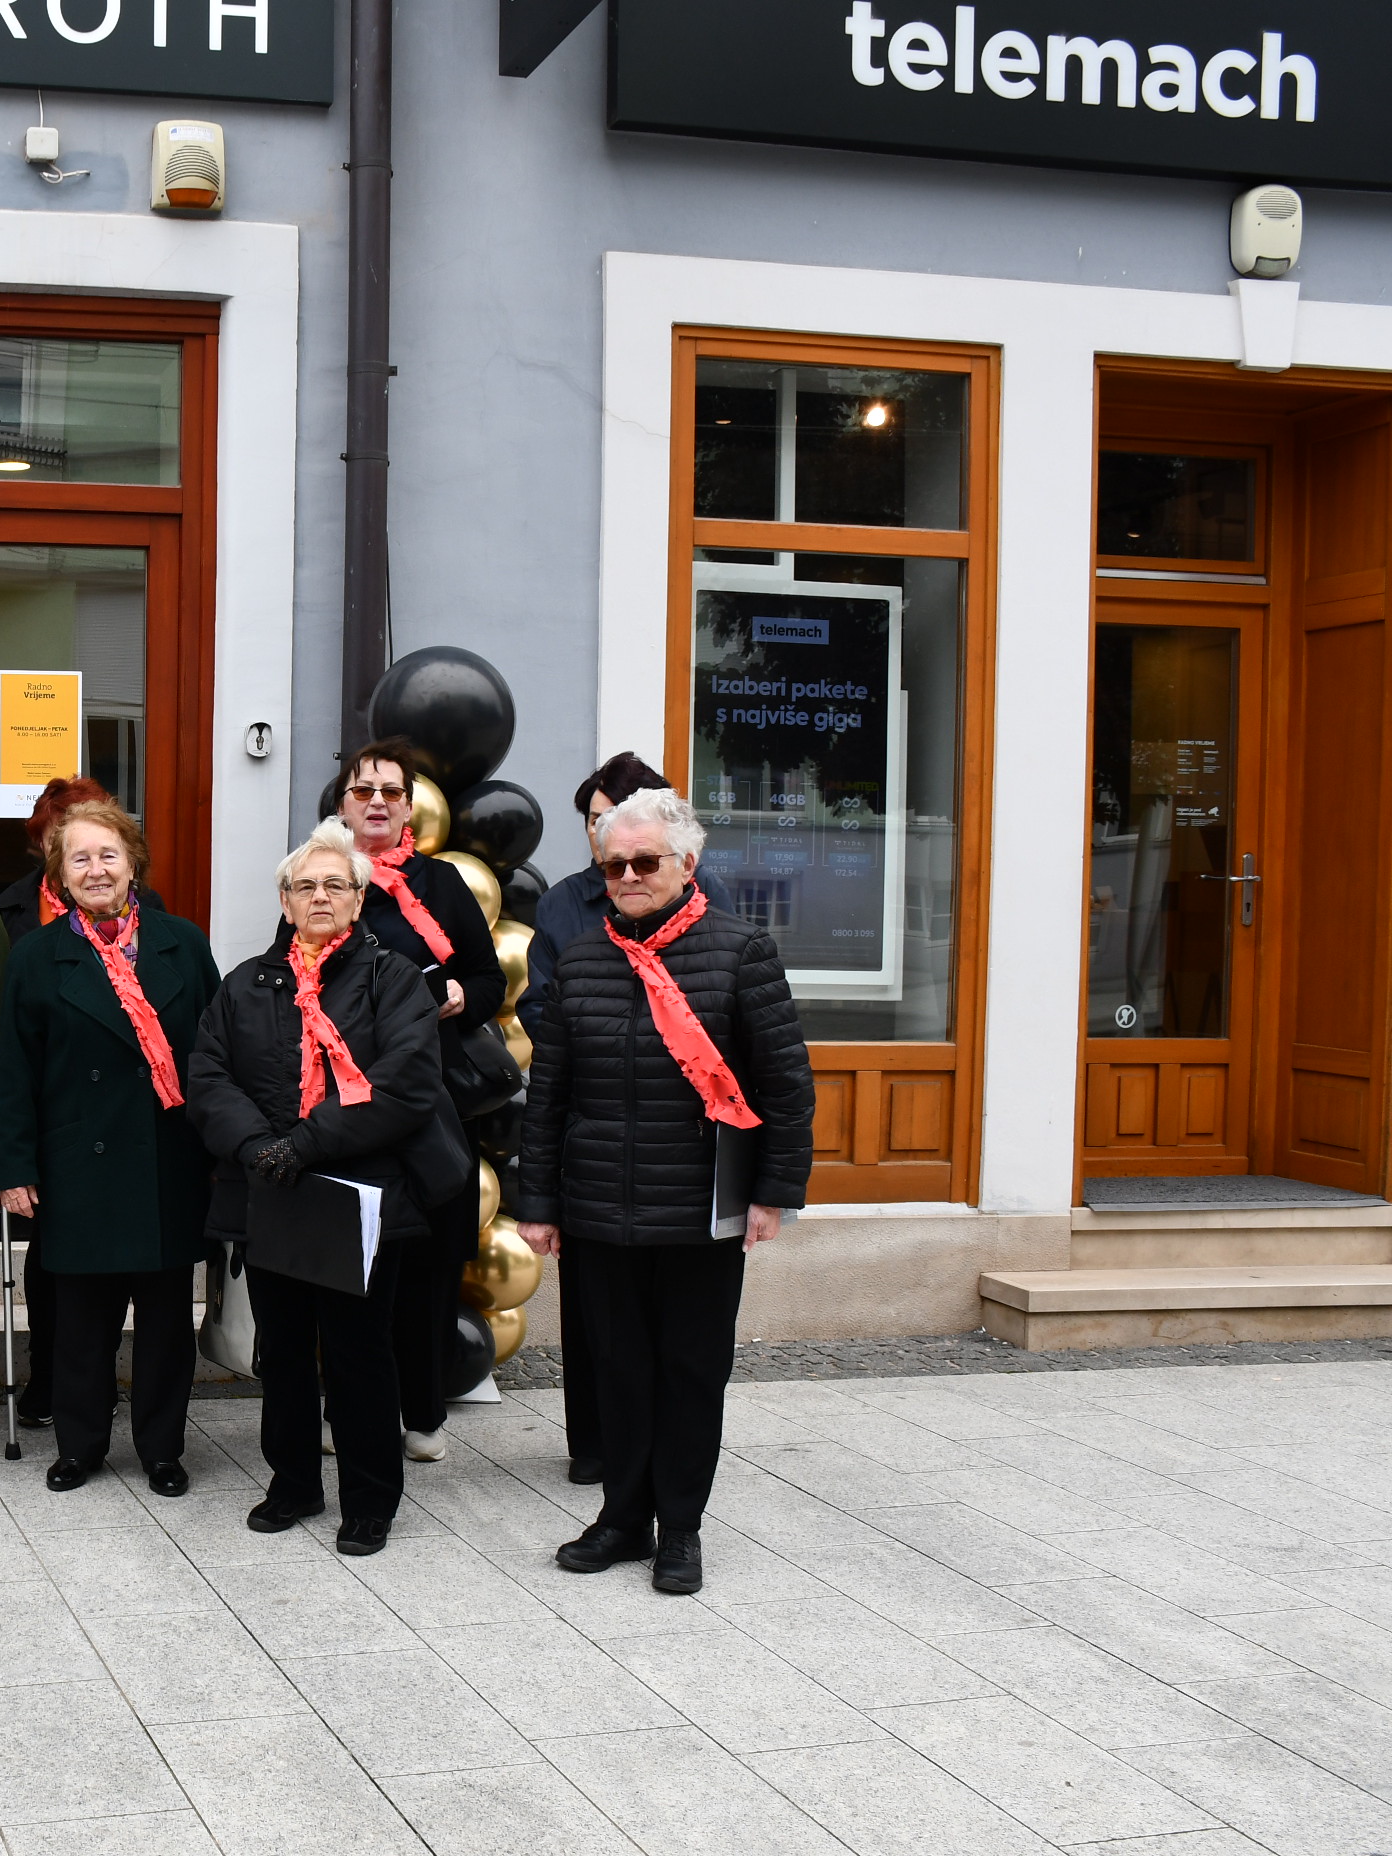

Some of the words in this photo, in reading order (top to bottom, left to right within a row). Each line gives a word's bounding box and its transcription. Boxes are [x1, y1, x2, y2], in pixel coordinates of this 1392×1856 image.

[845, 0, 1317, 122] telemach
[760, 624, 822, 638] telemach
[712, 675, 786, 696] Izaberi
[792, 679, 868, 702] pakete
[24, 691, 55, 700] Vrijeme
[716, 707, 727, 723] s
[733, 705, 809, 730] najviše
[814, 707, 862, 733] giga
[709, 792, 736, 803] 6GB
[770, 794, 806, 806] 40GB
[832, 929, 853, 937] 0800
